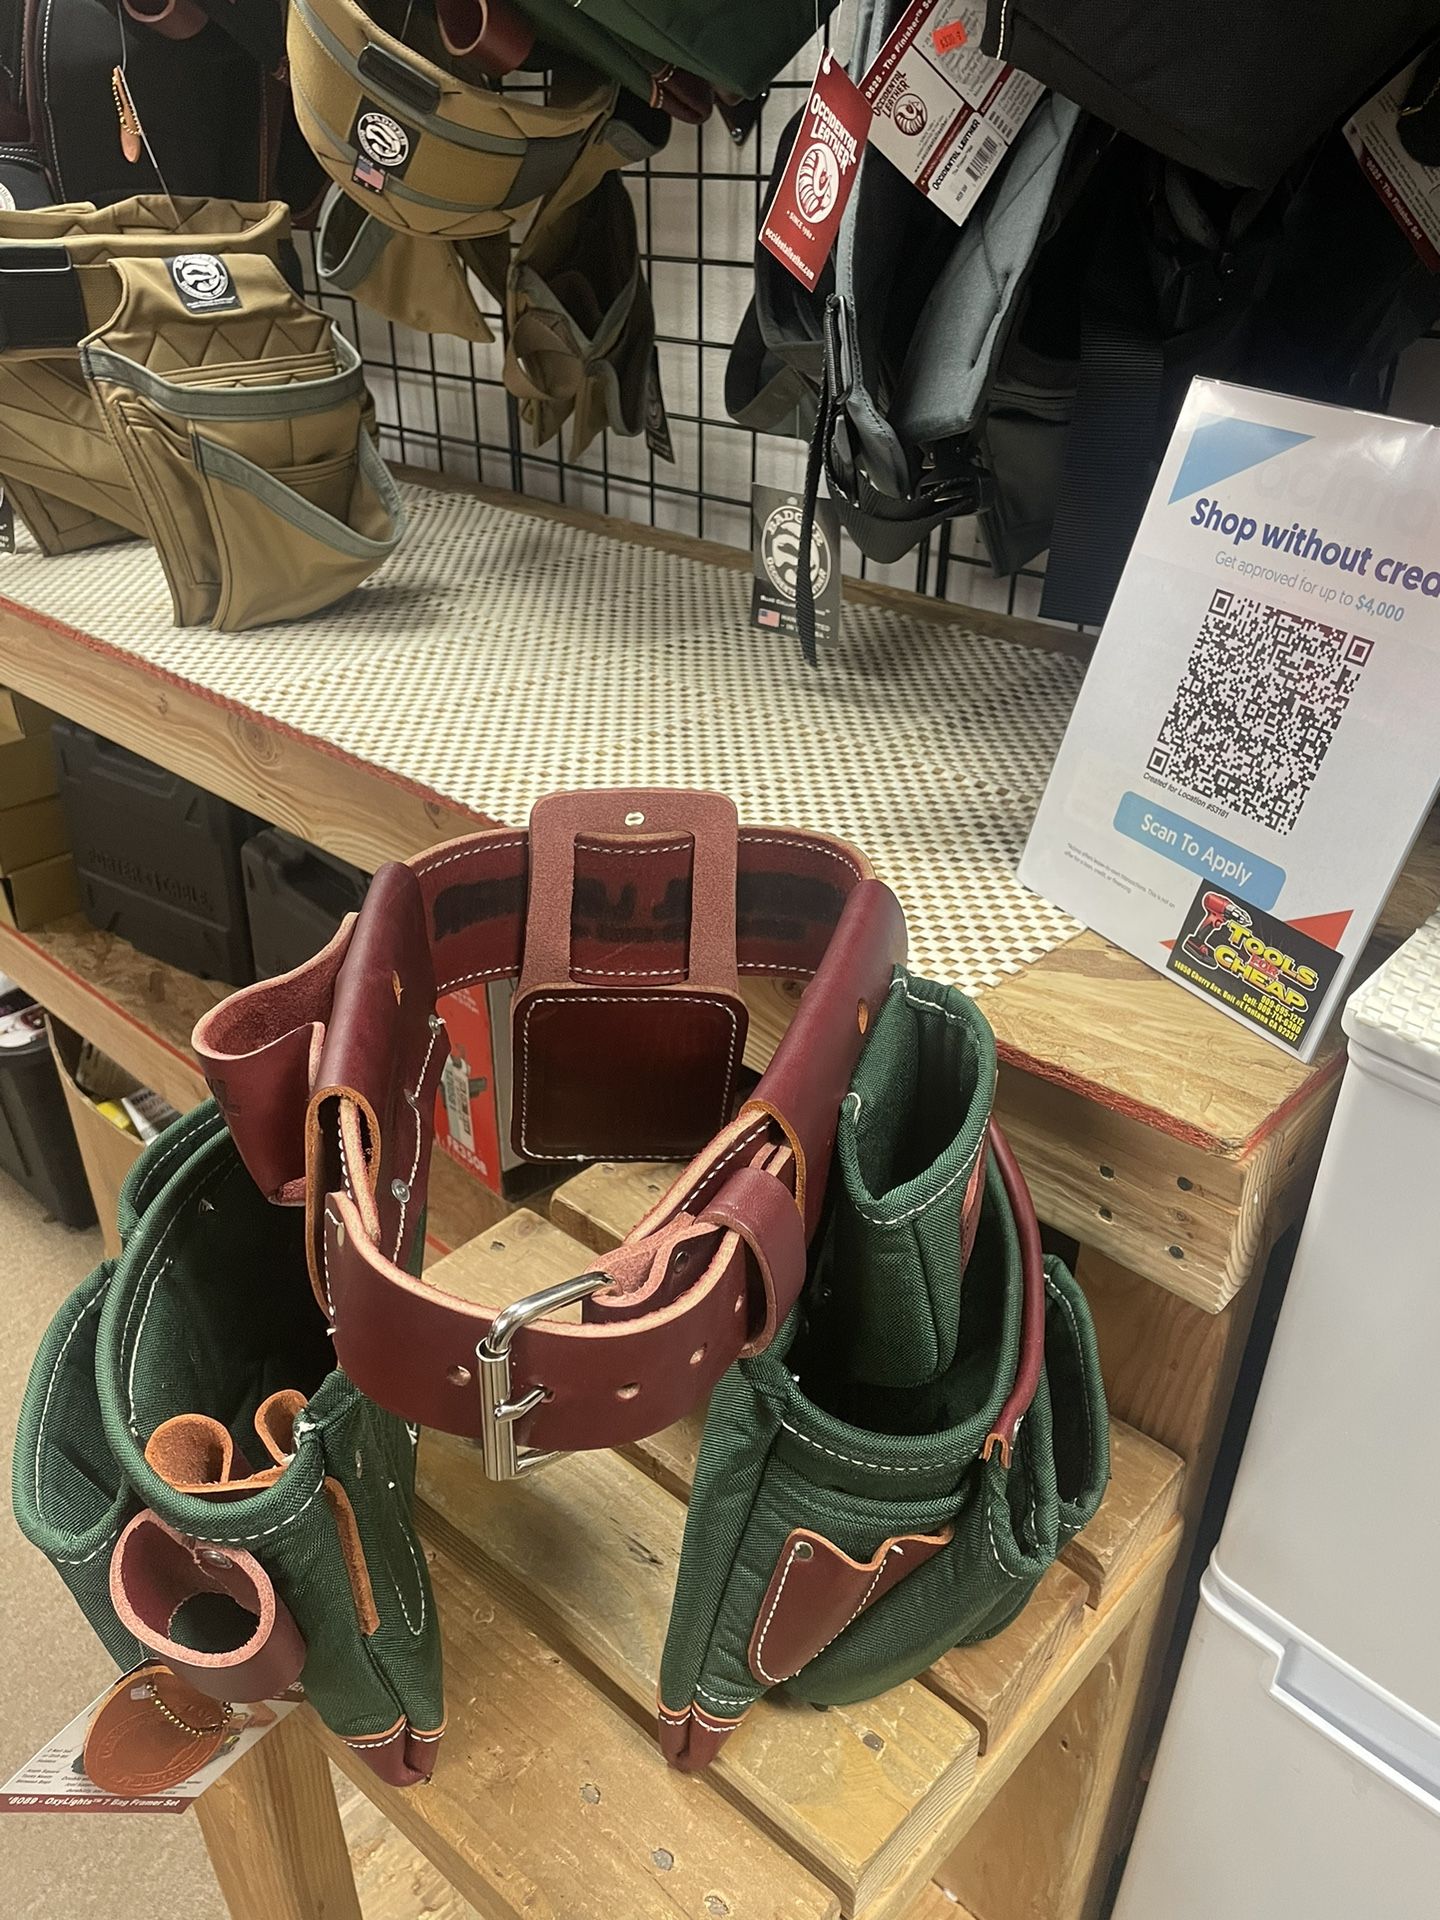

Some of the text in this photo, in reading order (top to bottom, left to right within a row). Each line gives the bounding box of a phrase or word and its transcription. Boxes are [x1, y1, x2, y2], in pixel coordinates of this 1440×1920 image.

[865, 75, 882, 99] 9525
[883, 53, 897, 70] The
[810, 93, 858, 164] OCCIDENTAL
[810, 115, 851, 175] LEATHER
[1190, 497, 1258, 545] Shop
[1261, 523, 1373, 576] without
[1215, 550, 1405, 623] Get approved for up to $4,000
[1143, 772, 1168, 789] Created
[1168, 784, 1178, 793] for
[1177, 789, 1206, 808] Location
[1140, 813, 1253, 888] Scan To Apply
[1215, 946, 1308, 1010] CHEAP
[1228, 920, 1318, 989] TOOLS
[1250, 955, 1279, 977] FOR
[1191, 970, 1211, 988] Cherry
[1268, 1020, 1278, 1030] CA
[110, 1798, 129, 1807] Bag
[129, 1798, 164, 1806] Framer
